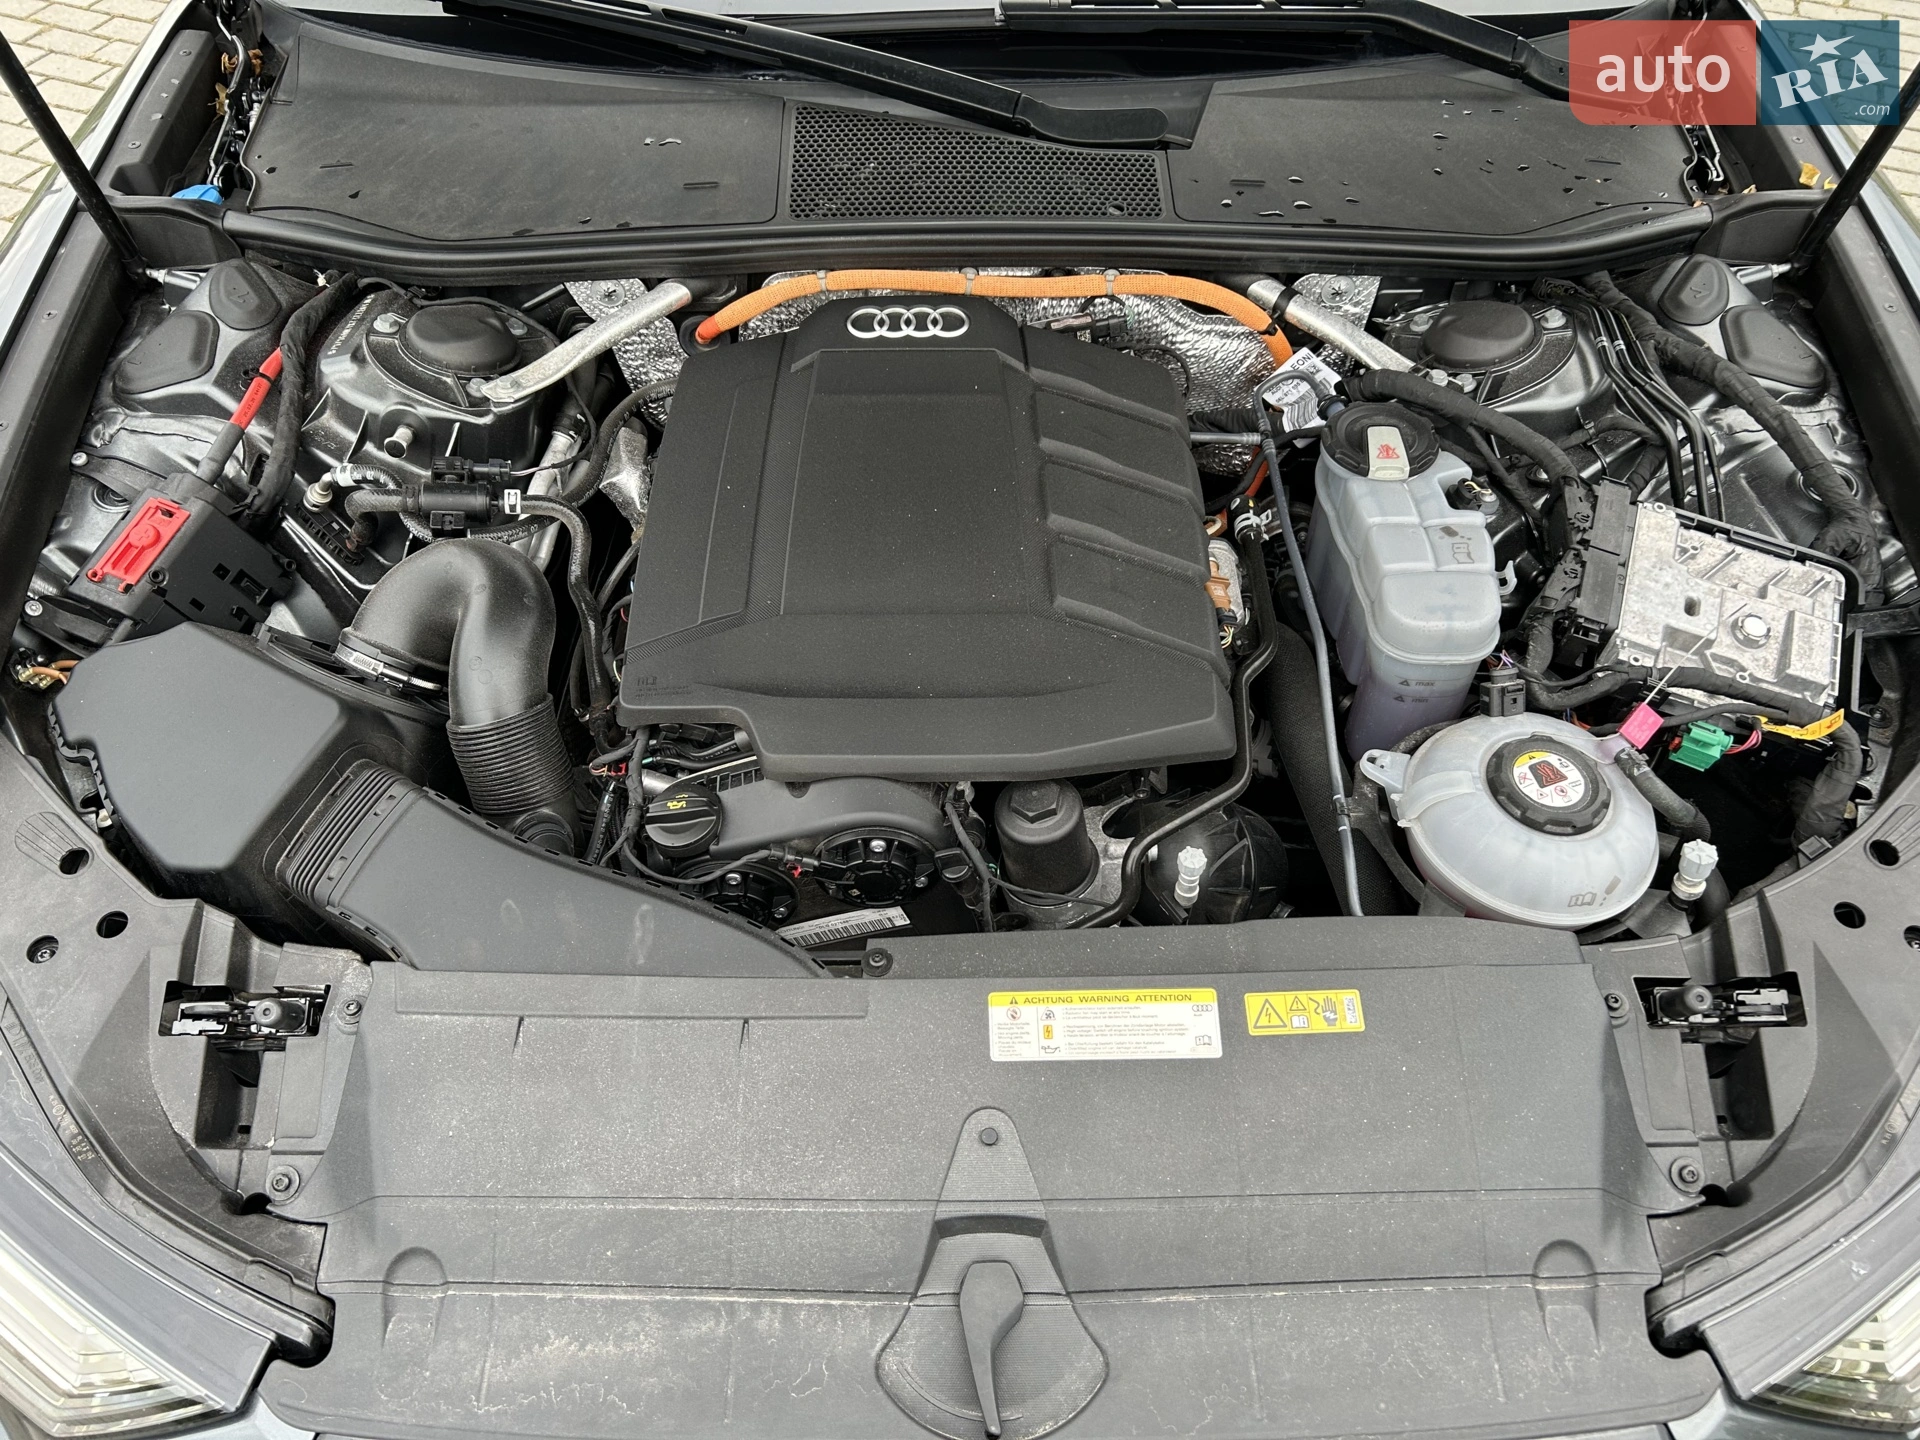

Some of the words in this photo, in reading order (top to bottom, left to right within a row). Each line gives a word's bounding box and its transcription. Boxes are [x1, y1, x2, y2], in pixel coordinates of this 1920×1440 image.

[1289, 353, 1314, 371] EONI
[1023, 996, 1073, 1004] ACHTUNG
[1078, 995, 1130, 1003] WARNING
[1135, 994, 1192, 1002] ATTENTION
